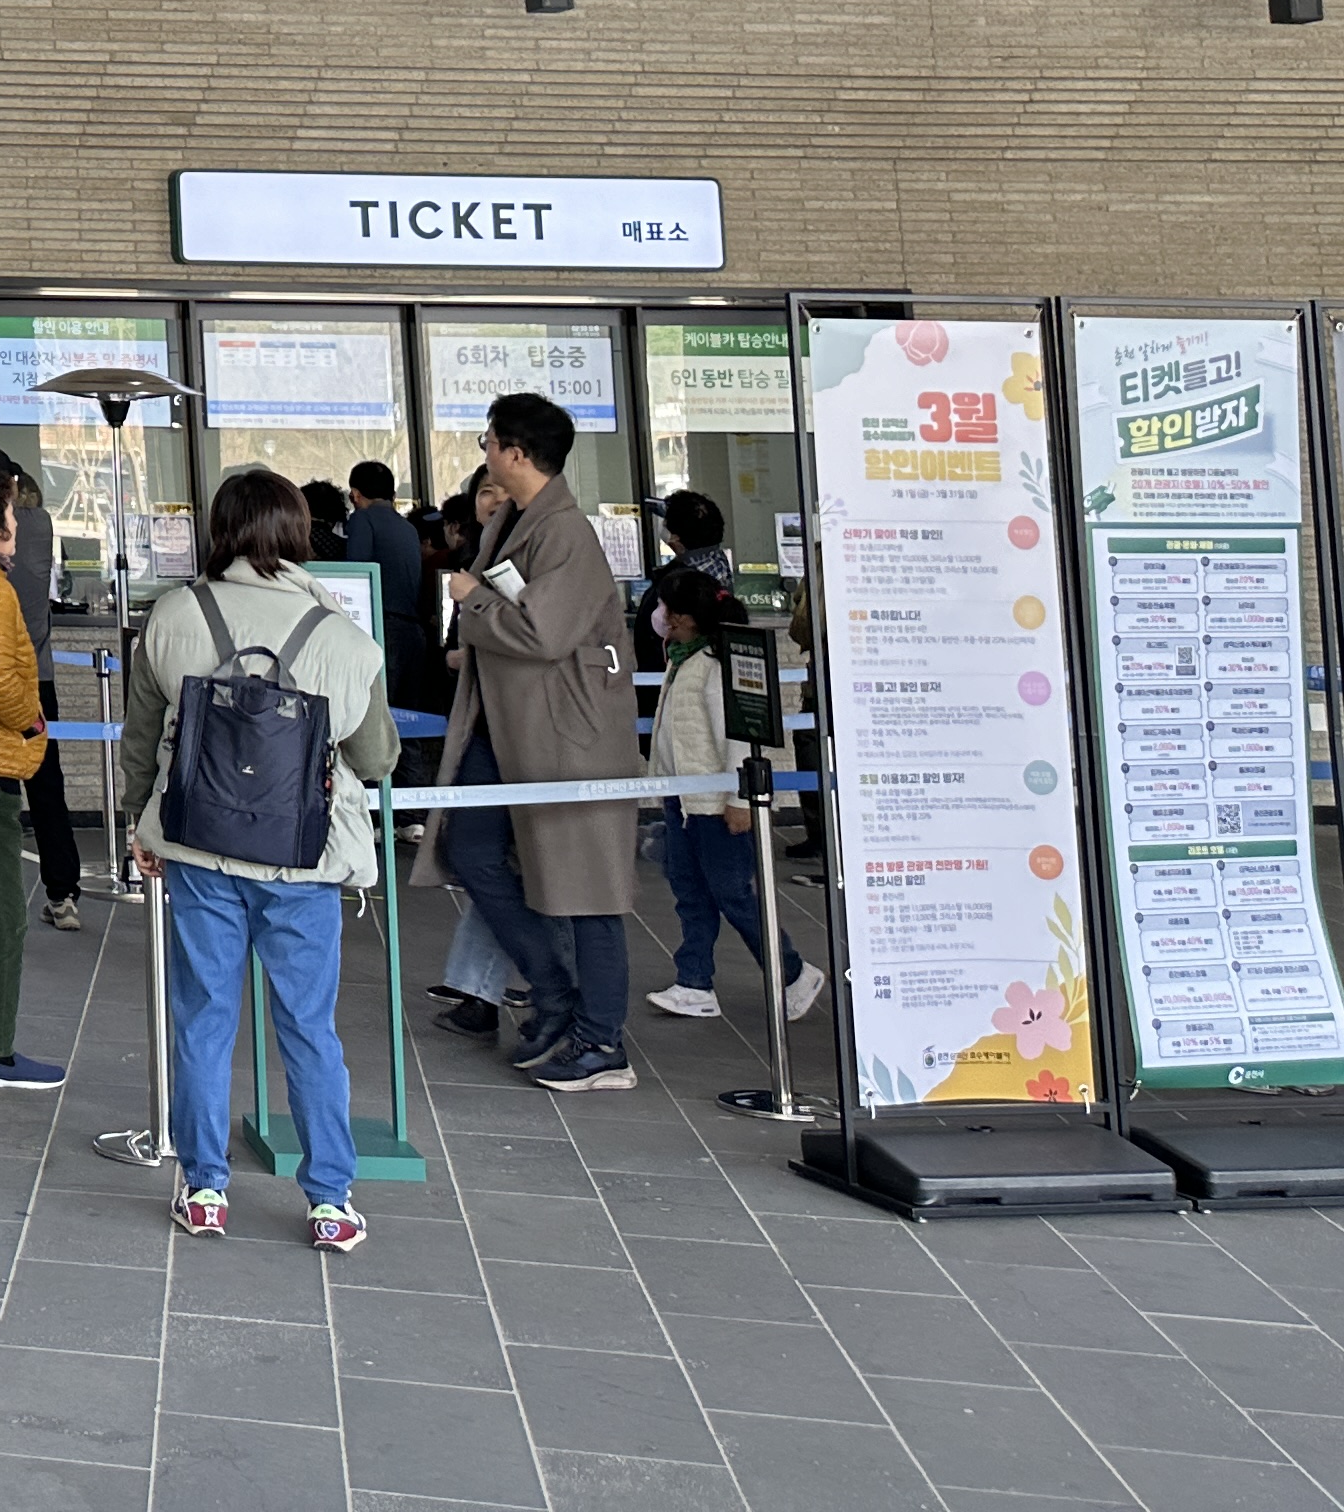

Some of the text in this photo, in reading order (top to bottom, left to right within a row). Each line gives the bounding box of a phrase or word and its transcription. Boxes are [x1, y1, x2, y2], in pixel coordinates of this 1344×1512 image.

[349, 200, 552, 241] TICKET
[622, 220, 689, 243] 매표소
[32, 320, 110, 336] 할인 이용 안내
[684, 332, 789, 348] 케이블카 탑승안내
[16, 350, 55, 366] 대상자
[59, 352, 100, 368] 신분증
[456, 344, 587, 369] 6회차 탑승중
[1114, 345, 1135, 367] 춘천
[1138, 340, 1173, 362] 알차게
[670, 368, 697, 388] 6인
[701, 369, 734, 388] 동반
[737, 369, 771, 389] 탑승
[1119, 350, 1242, 406] 티켓들고!
[549, 380, 592, 395] 15:00
[917, 391, 999, 443] 3월
[1128, 396, 1249, 454] 할인받자
[864, 448, 1003, 482] 할인이벤트
[842, 528, 872, 540] 신학기
[899, 529, 919, 540] 학생
[921, 529, 944, 541] 할인!
[848, 609, 921, 621] 생일 축하합니다!
[853, 681, 942, 693] 티켓 들고! 할인 받자!
[859, 774, 878, 785] 호텔
[923, 773, 940, 784] 할인
[865, 859, 989, 873] 춘천 방문 관광객 천만명 기원!
[866, 874, 926, 887] 춘천시민 할인!
